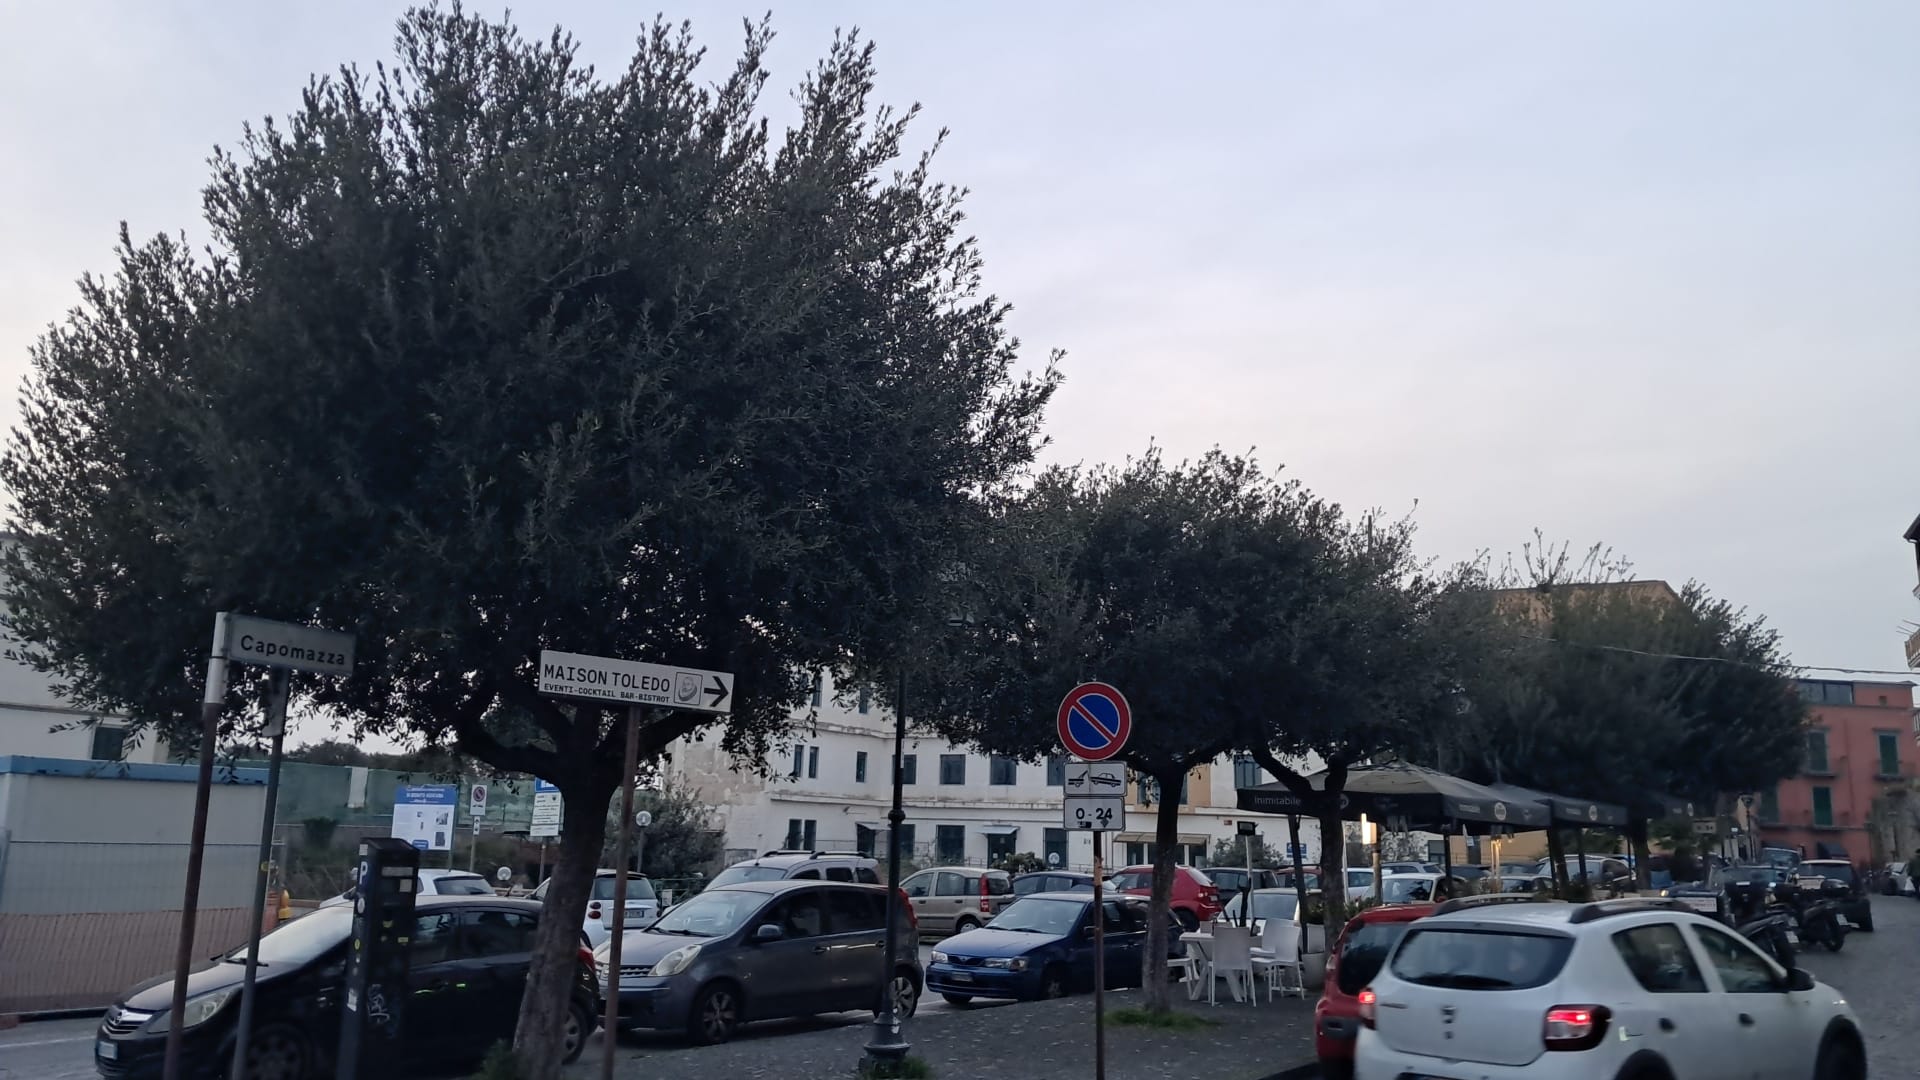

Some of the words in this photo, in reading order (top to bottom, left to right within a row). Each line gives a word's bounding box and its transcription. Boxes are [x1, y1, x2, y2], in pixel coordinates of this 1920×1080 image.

[240, 635, 345, 664] Capomazza
[544, 664, 607, 685] MAISON
[612, 672, 671, 692] TOLEDO
[1095, 807, 1112, 819] 24
